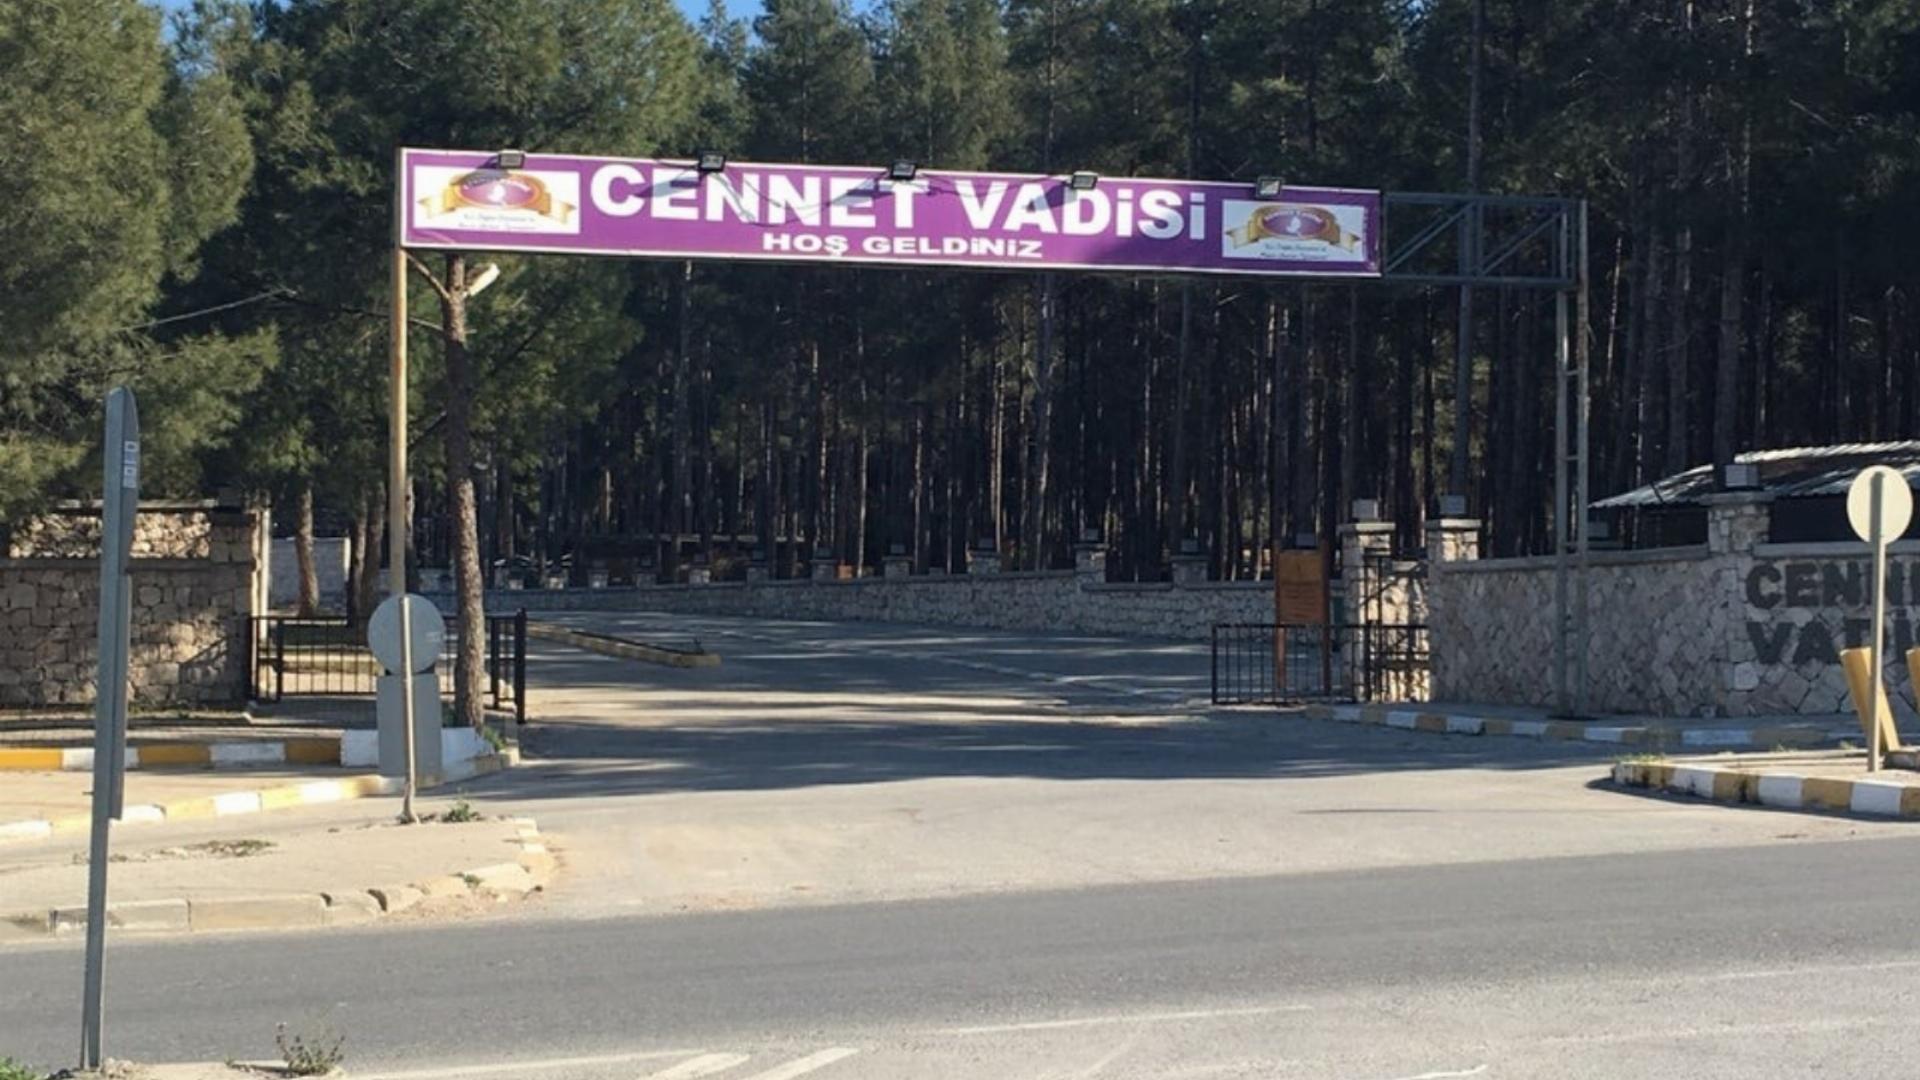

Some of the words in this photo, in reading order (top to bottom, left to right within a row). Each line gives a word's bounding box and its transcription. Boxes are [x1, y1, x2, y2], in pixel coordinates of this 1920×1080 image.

[590, 164, 930, 229] CENNET
[762, 232, 848, 257] HOŞ
[1745, 560, 1920, 609] CENN
